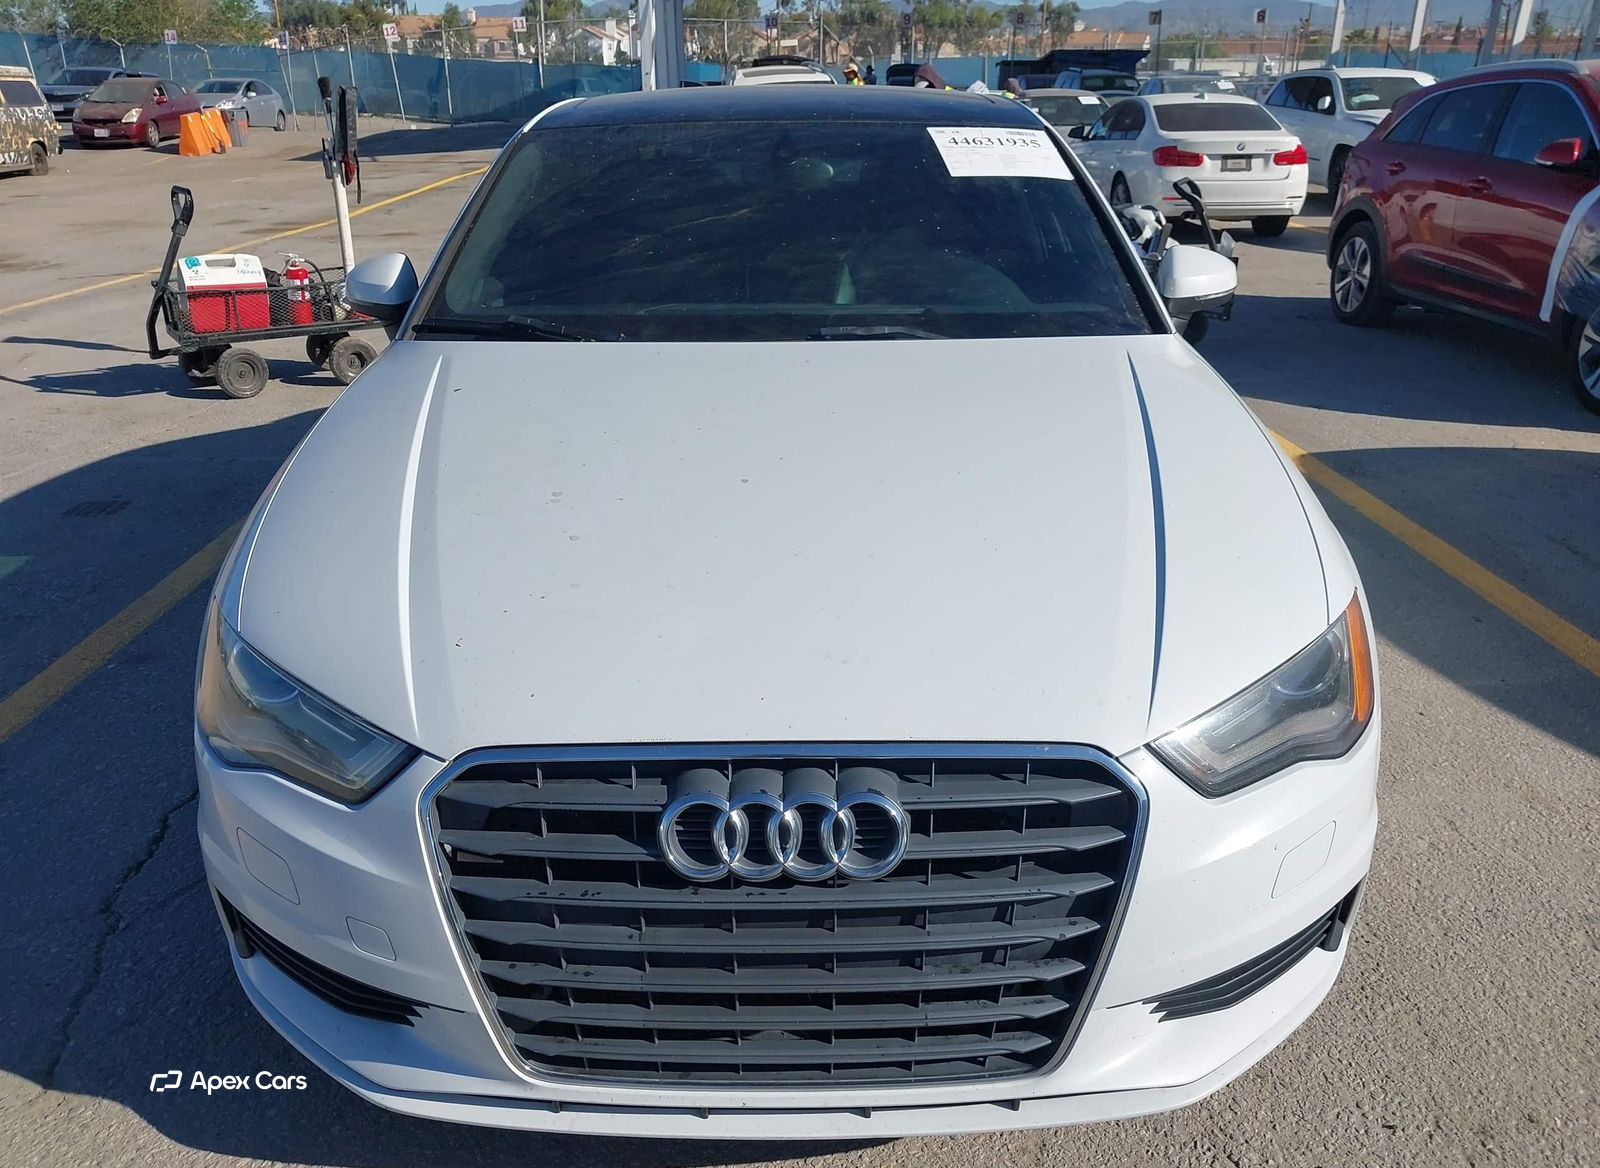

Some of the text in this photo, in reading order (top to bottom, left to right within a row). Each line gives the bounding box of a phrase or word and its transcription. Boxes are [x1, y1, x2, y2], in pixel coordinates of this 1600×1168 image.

[513, 19, 526, 29] 11
[765, 17, 778, 27] 10
[903, 14, 911, 25] 9
[385, 26, 397, 36] 12
[165, 33, 176, 42] 14
[948, 136, 1042, 149] 44631935
